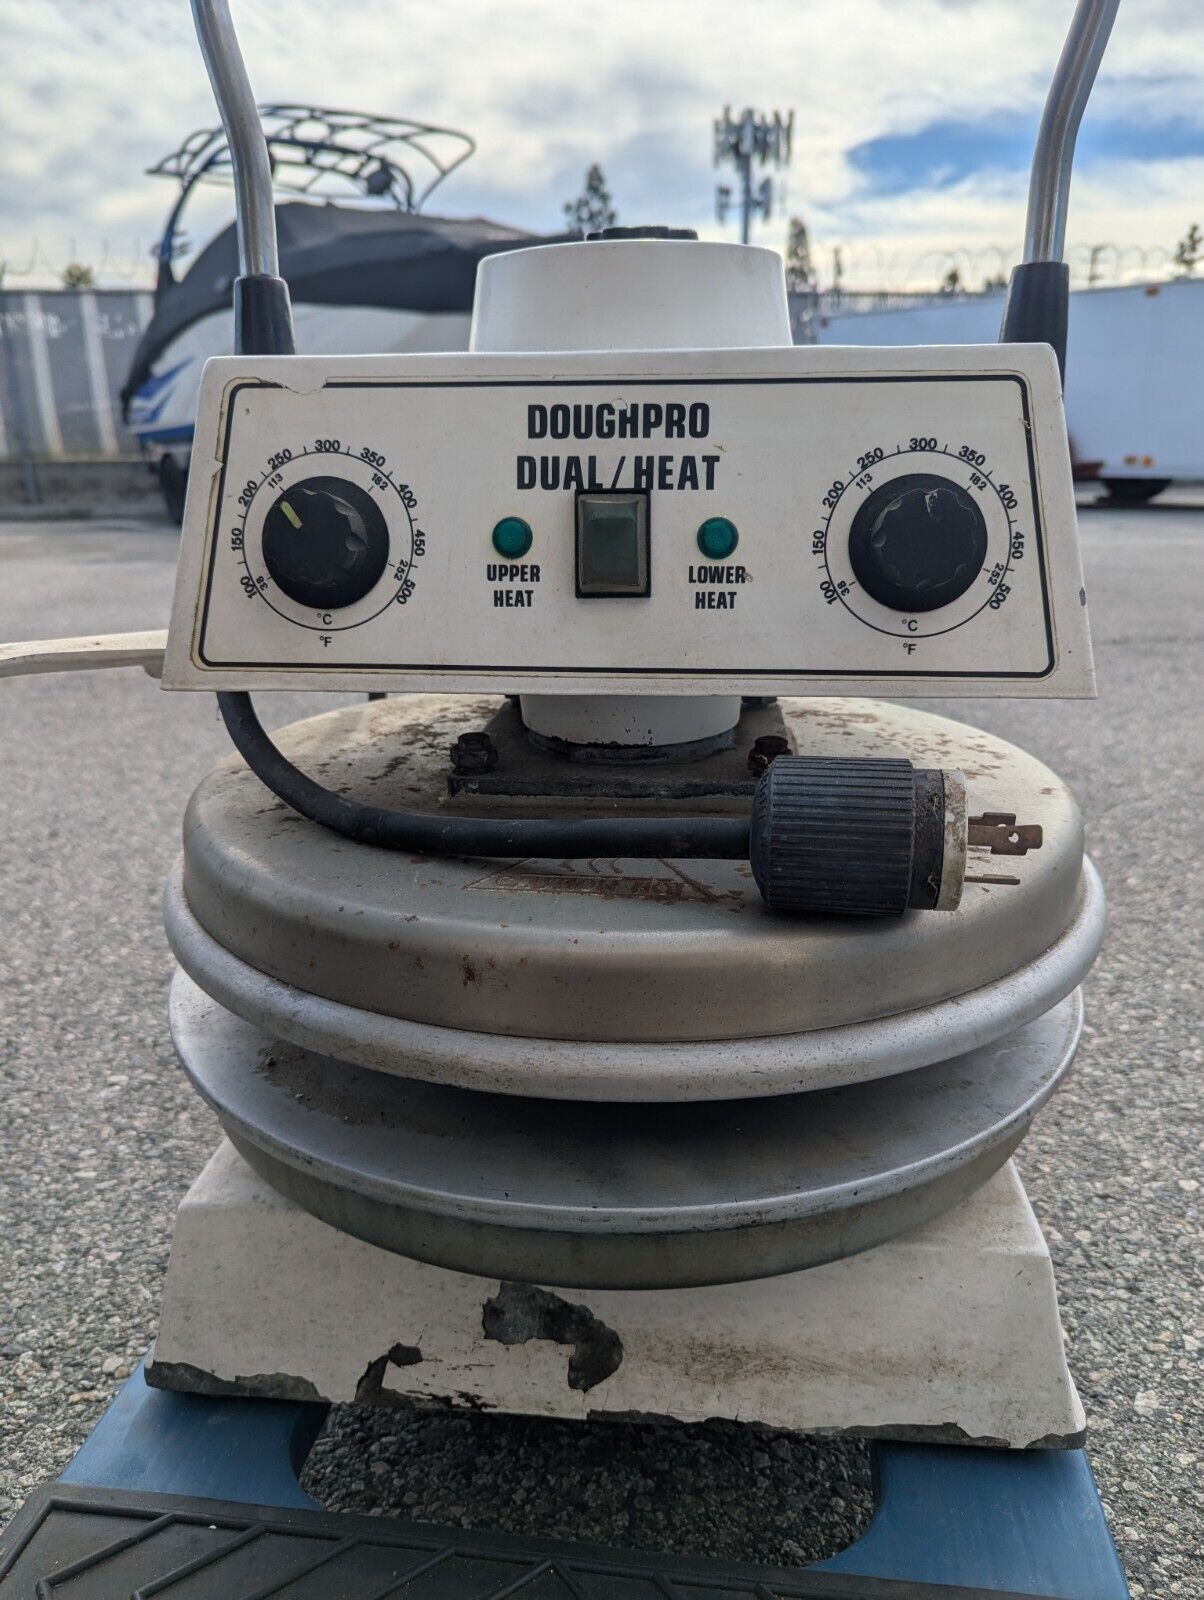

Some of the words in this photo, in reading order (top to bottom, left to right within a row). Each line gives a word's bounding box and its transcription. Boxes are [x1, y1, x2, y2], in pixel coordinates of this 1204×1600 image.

[527, 402, 710, 439] DOUGHPRO
[314, 439, 341, 451] 300
[909, 437, 938, 450] 300
[267, 448, 293, 470] 250
[360, 447, 386, 467] 350
[856, 447, 884, 470] 250
[958, 445, 986, 467] 350
[267, 473, 284, 490] 113
[371, 473, 389, 492] 182
[855, 472, 873, 490] 113
[969, 472, 988, 492] 182
[238, 480, 258, 507] 200
[398, 483, 418, 509] 400
[822, 480, 845, 509] 200
[998, 483, 1018, 510] 400
[231, 527, 243, 552] 150
[413, 529, 426, 557] 450
[812, 530, 825, 555] 150
[1011, 531, 1025, 560] 450
[393, 559, 408, 582] 252
[486, 564, 541, 583] UPPER
[688, 565, 746, 584] LOWER
[987, 562, 1004, 586] 252
[240, 576, 257, 600] 100
[256, 575, 269, 591] 38
[396, 579, 416, 605] 500
[820, 580, 838, 605] 100
[837, 580, 850, 596] 38
[493, 589, 534, 608] HEAT
[695, 591, 737, 610] HEAT
[989, 584, 1011, 610] 500
